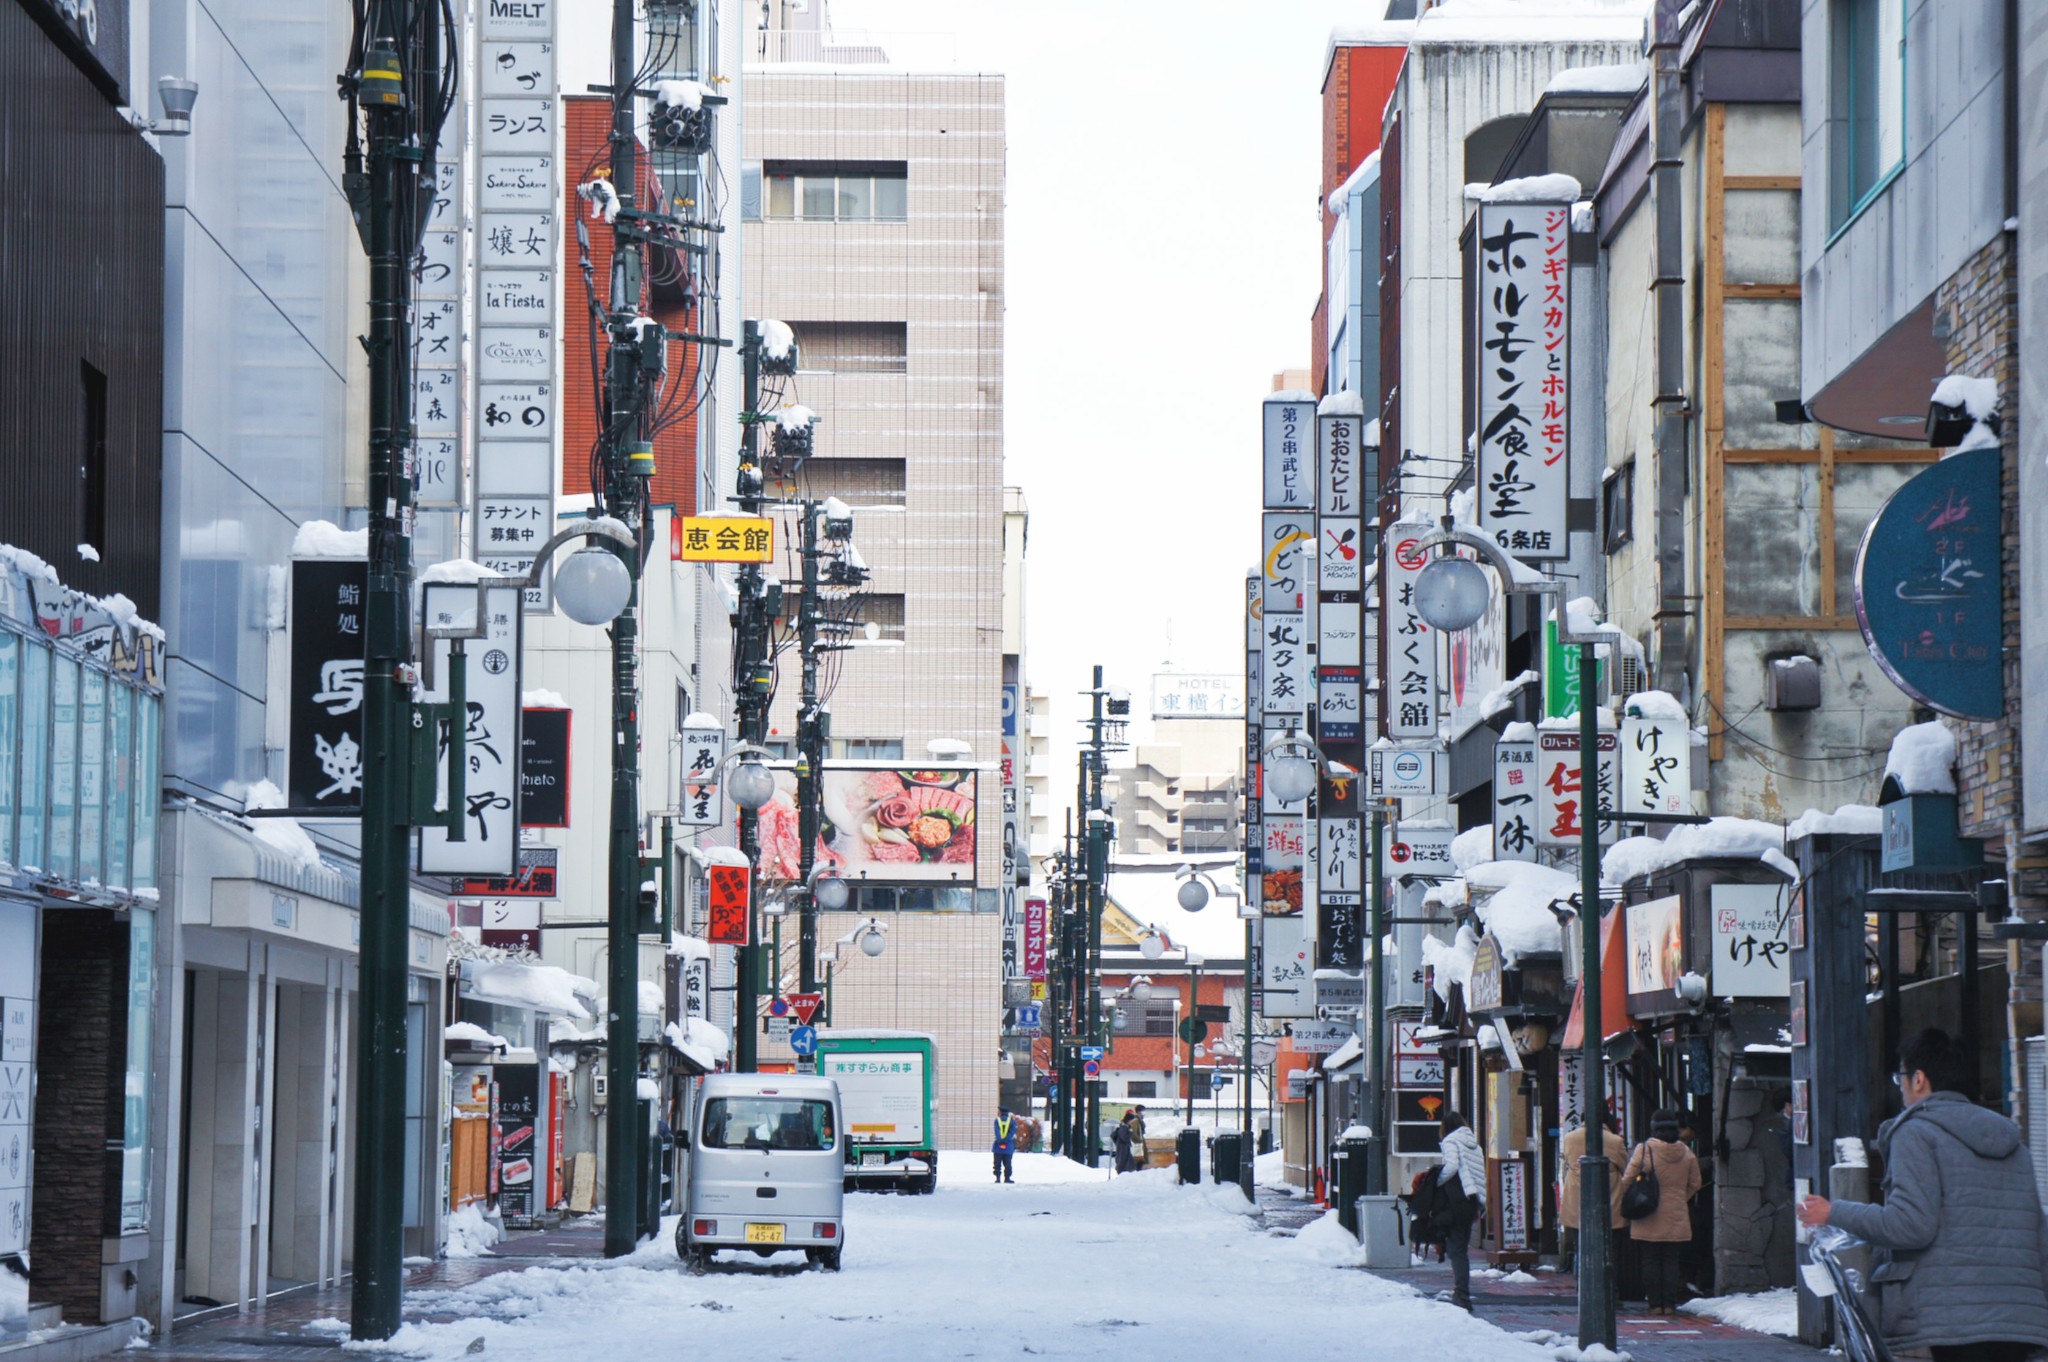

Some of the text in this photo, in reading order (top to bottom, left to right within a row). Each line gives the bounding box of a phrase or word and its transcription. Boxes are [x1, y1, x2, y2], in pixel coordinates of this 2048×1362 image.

[490, 0, 545, 18] MELT
[489, 115, 546, 135] ランス
[488, 227, 546, 256] 嬢女
[487, 292, 545, 308] la Fiesta
[494, 348, 543, 357] OGAWA
[1541, 210, 1567, 467] ジンギスカンとホルモン
[1482, 218, 1539, 518] ホルモン食堂
[426, 398, 447, 421] 森
[1282, 407, 1297, 503] 第2串武ビル
[1331, 420, 1350, 512] おおたビル
[484, 506, 541, 520] テナント
[490, 527, 534, 542] 募集中
[686, 527, 769, 552] 恵会館
[337, 583, 360, 635] 鮨処
[1333, 593, 1348, 603] 4F
[1268, 625, 1299, 698] 北乃家
[1498, 750, 1534, 763] 居酒屋
[1637, 726, 1679, 810] けやき
[1544, 762, 1582, 837] 仁王
[1497, 793, 1534, 854] 一休
[1329, 895, 1353, 904] B1F
[1028, 905, 1042, 965] カラオケ
[1330, 909, 1348, 965] おでん処
[1564, 1055, 1582, 1133] ホルモン食
